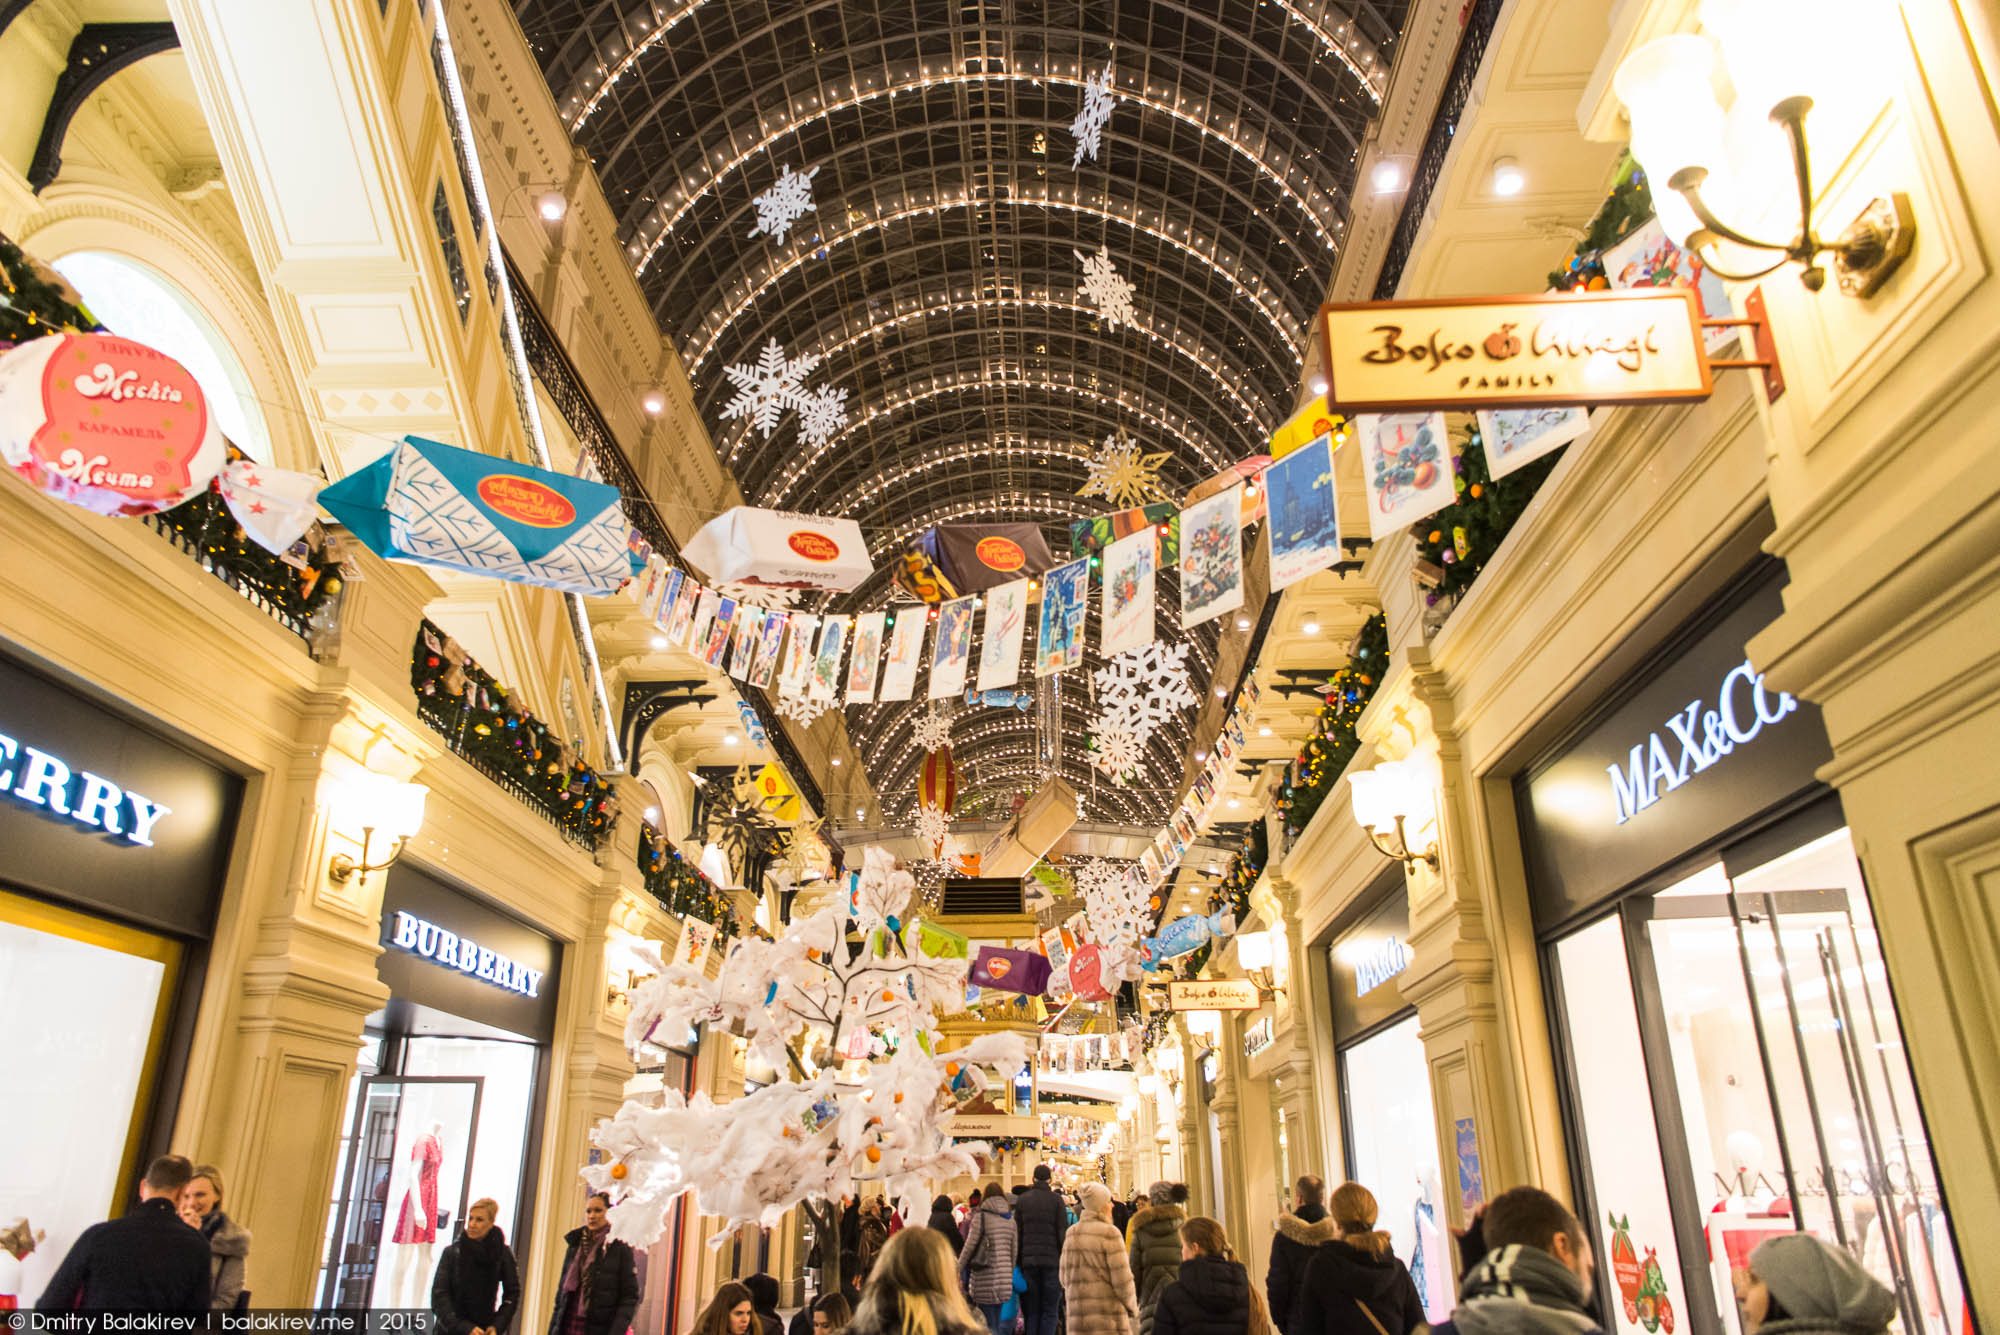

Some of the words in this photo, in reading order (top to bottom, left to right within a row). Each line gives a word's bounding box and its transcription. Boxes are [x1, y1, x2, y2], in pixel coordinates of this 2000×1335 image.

[1361, 324, 1476, 373] Bosco
[75, 363, 182, 402] Mechta
[1458, 374, 1556, 389] FAMILY
[78, 420, 166, 440] КАРАМЕЛЬ
[46, 448, 153, 488] Мечта
[393, 910, 543, 998] BURBERRY
